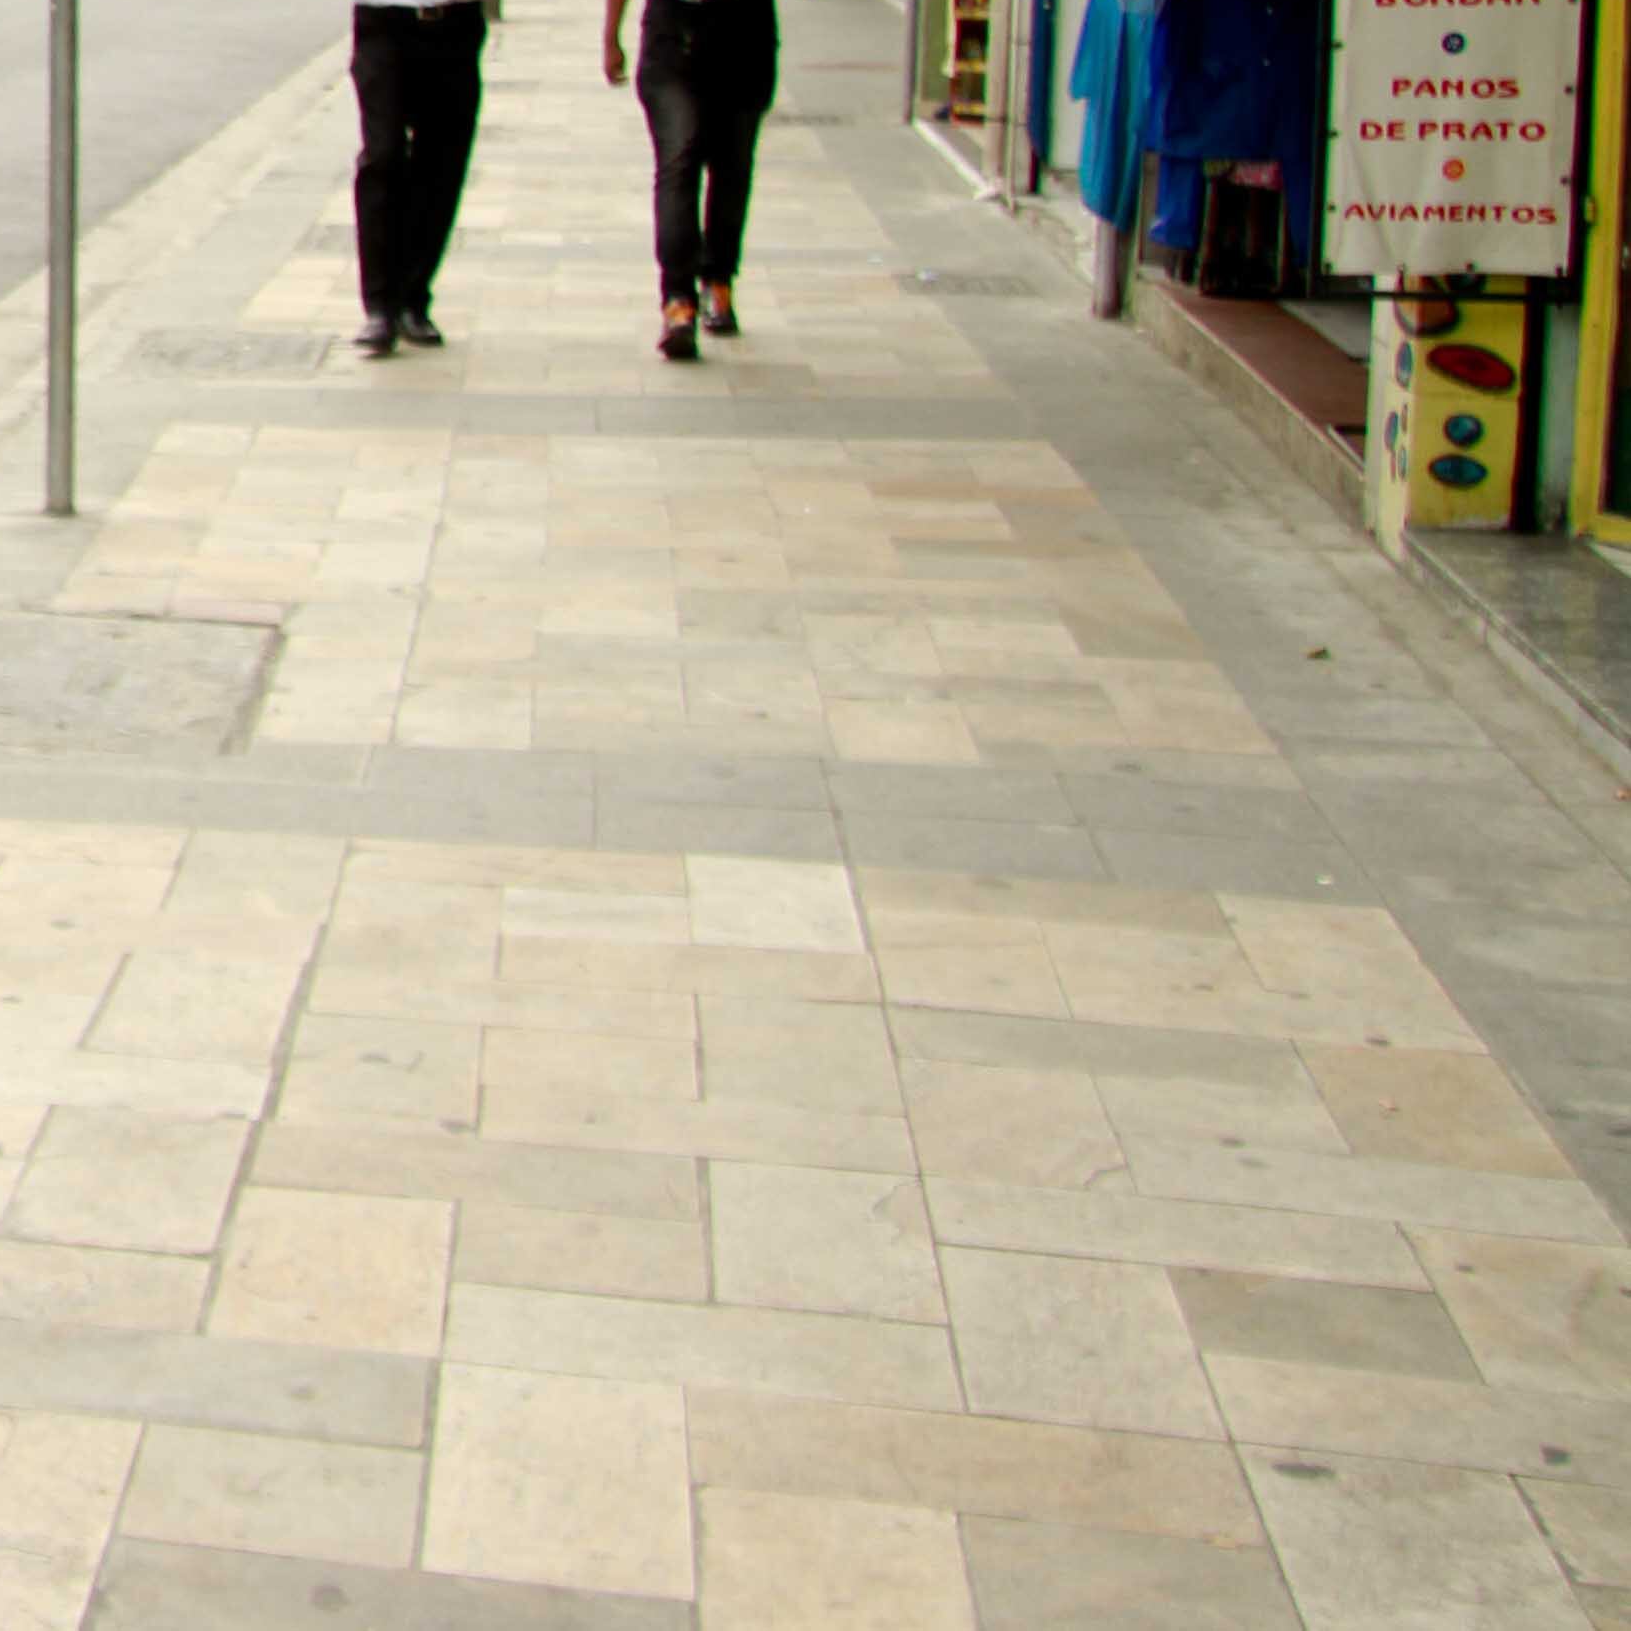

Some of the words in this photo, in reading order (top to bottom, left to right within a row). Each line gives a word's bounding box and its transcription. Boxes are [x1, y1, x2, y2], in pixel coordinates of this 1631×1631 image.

[1390, 77, 1521, 99] PANOS
[1359, 120, 1406, 142] DE
[1417, 120, 1547, 143] PRATO
[1344, 202, 1558, 226] AVIAMENTOS
